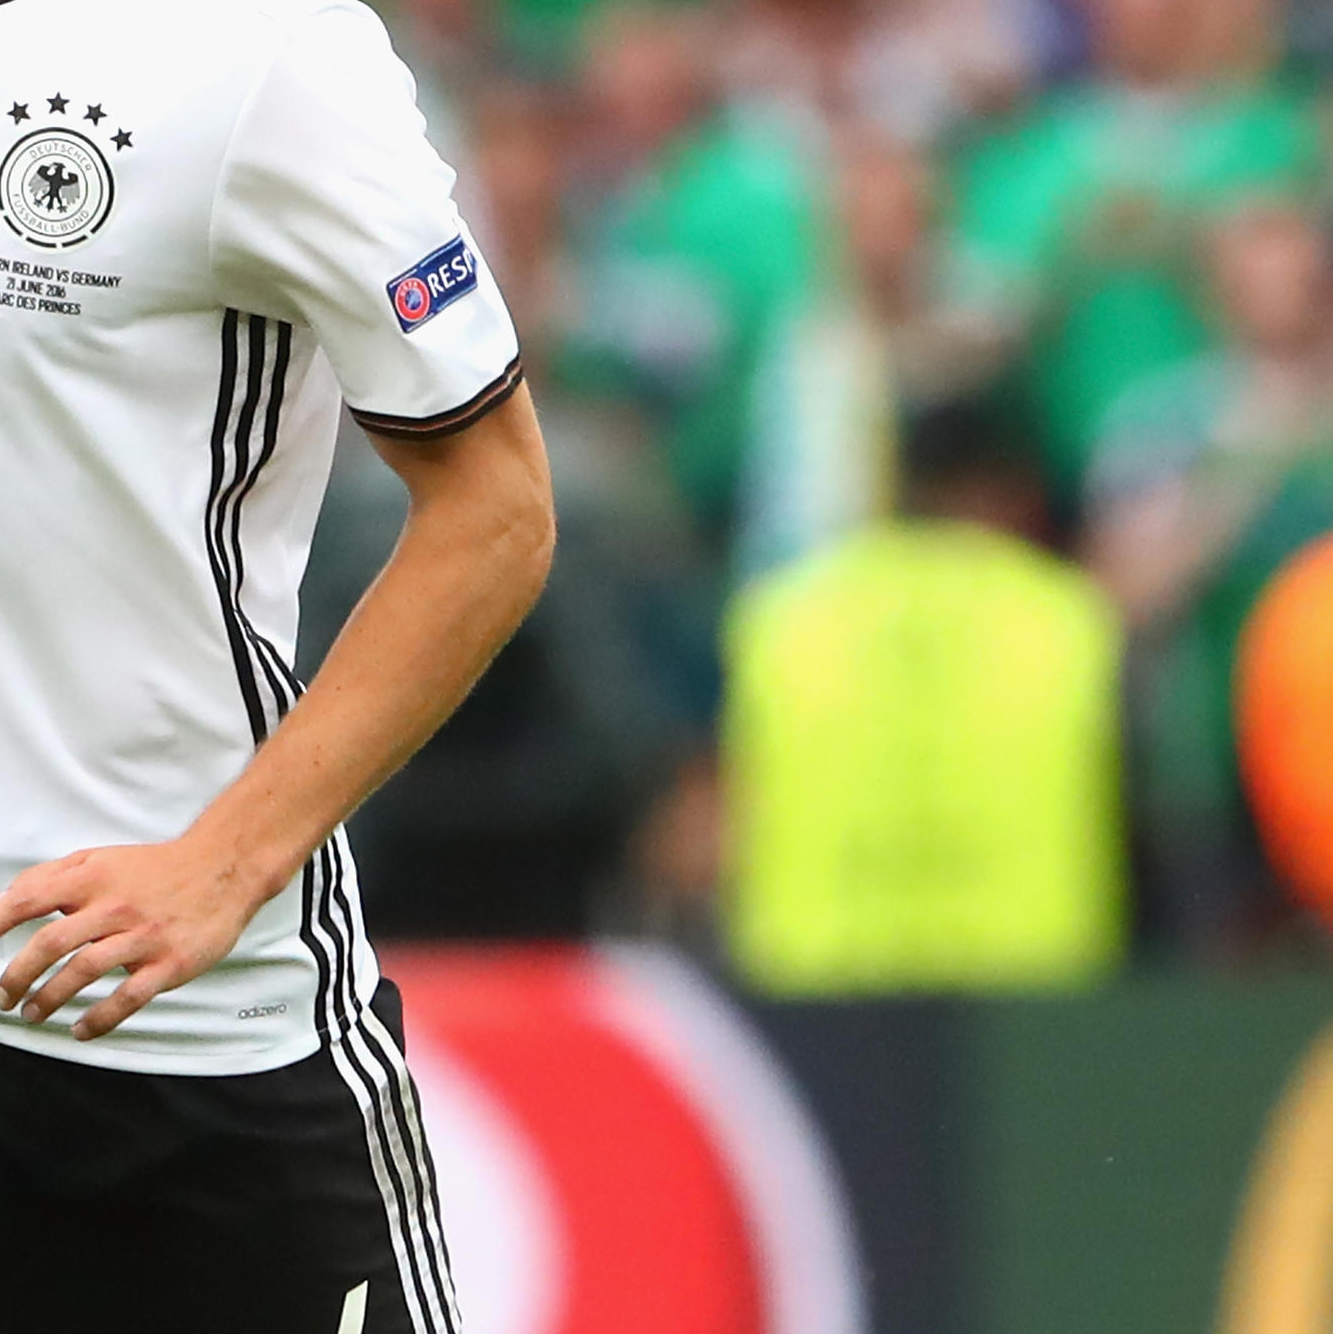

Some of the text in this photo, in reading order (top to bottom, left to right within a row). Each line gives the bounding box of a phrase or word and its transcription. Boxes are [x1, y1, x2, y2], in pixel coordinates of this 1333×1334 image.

[29, 142, 92, 171] DEUTSCHER
[12, 261, 54, 280] IRELAND
[56, 269, 69, 282] VS
[71, 272, 122, 288] GERMANY
[6, 277, 66, 298] 21 JUNE 2016
[16, 295, 37, 310] DES
[38, 299, 81, 315] PRINCES
